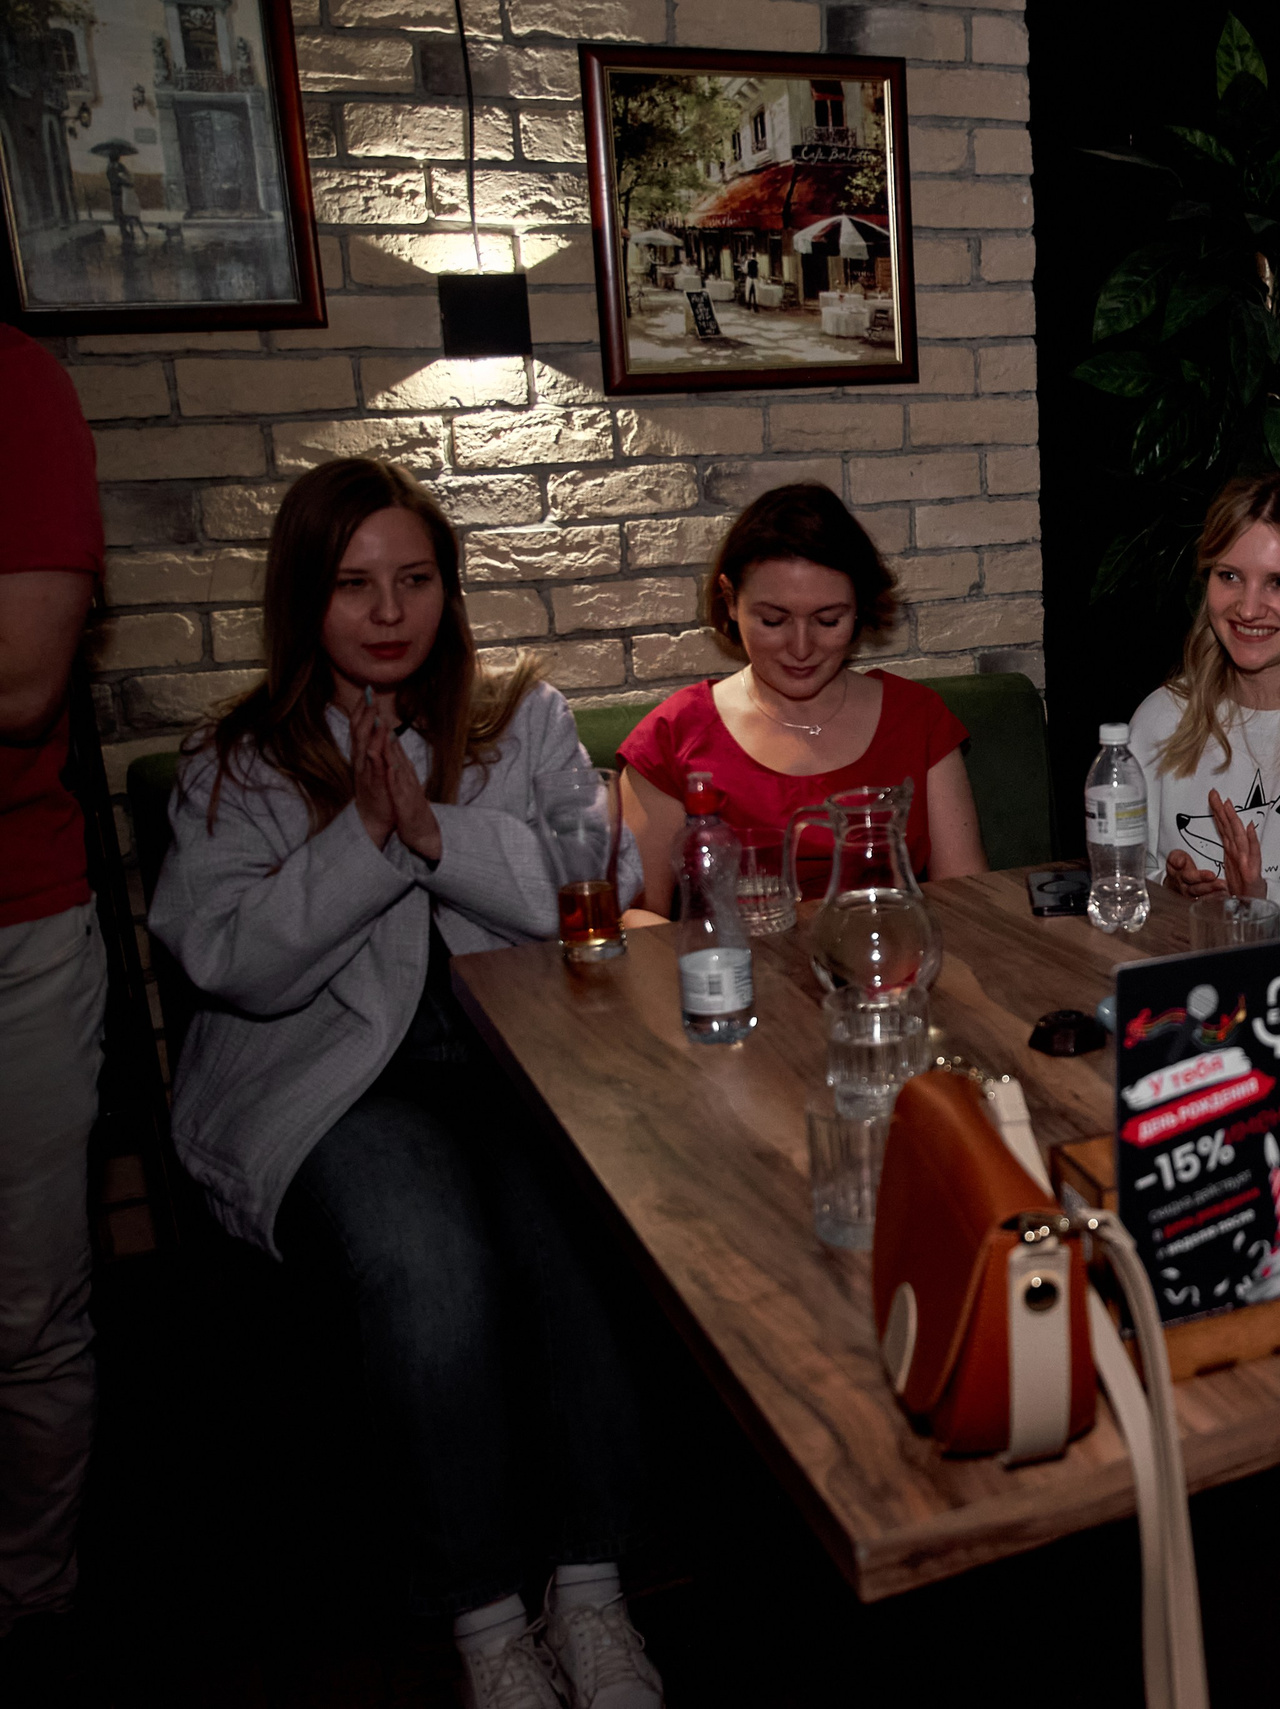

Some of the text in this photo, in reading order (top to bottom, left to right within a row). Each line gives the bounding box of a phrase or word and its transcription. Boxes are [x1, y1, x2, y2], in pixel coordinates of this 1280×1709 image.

[1138, 1077, 1260, 1143] ДЕНЬ РОЖДЕНИЯ
[1134, 1128, 1236, 1191] -15%
